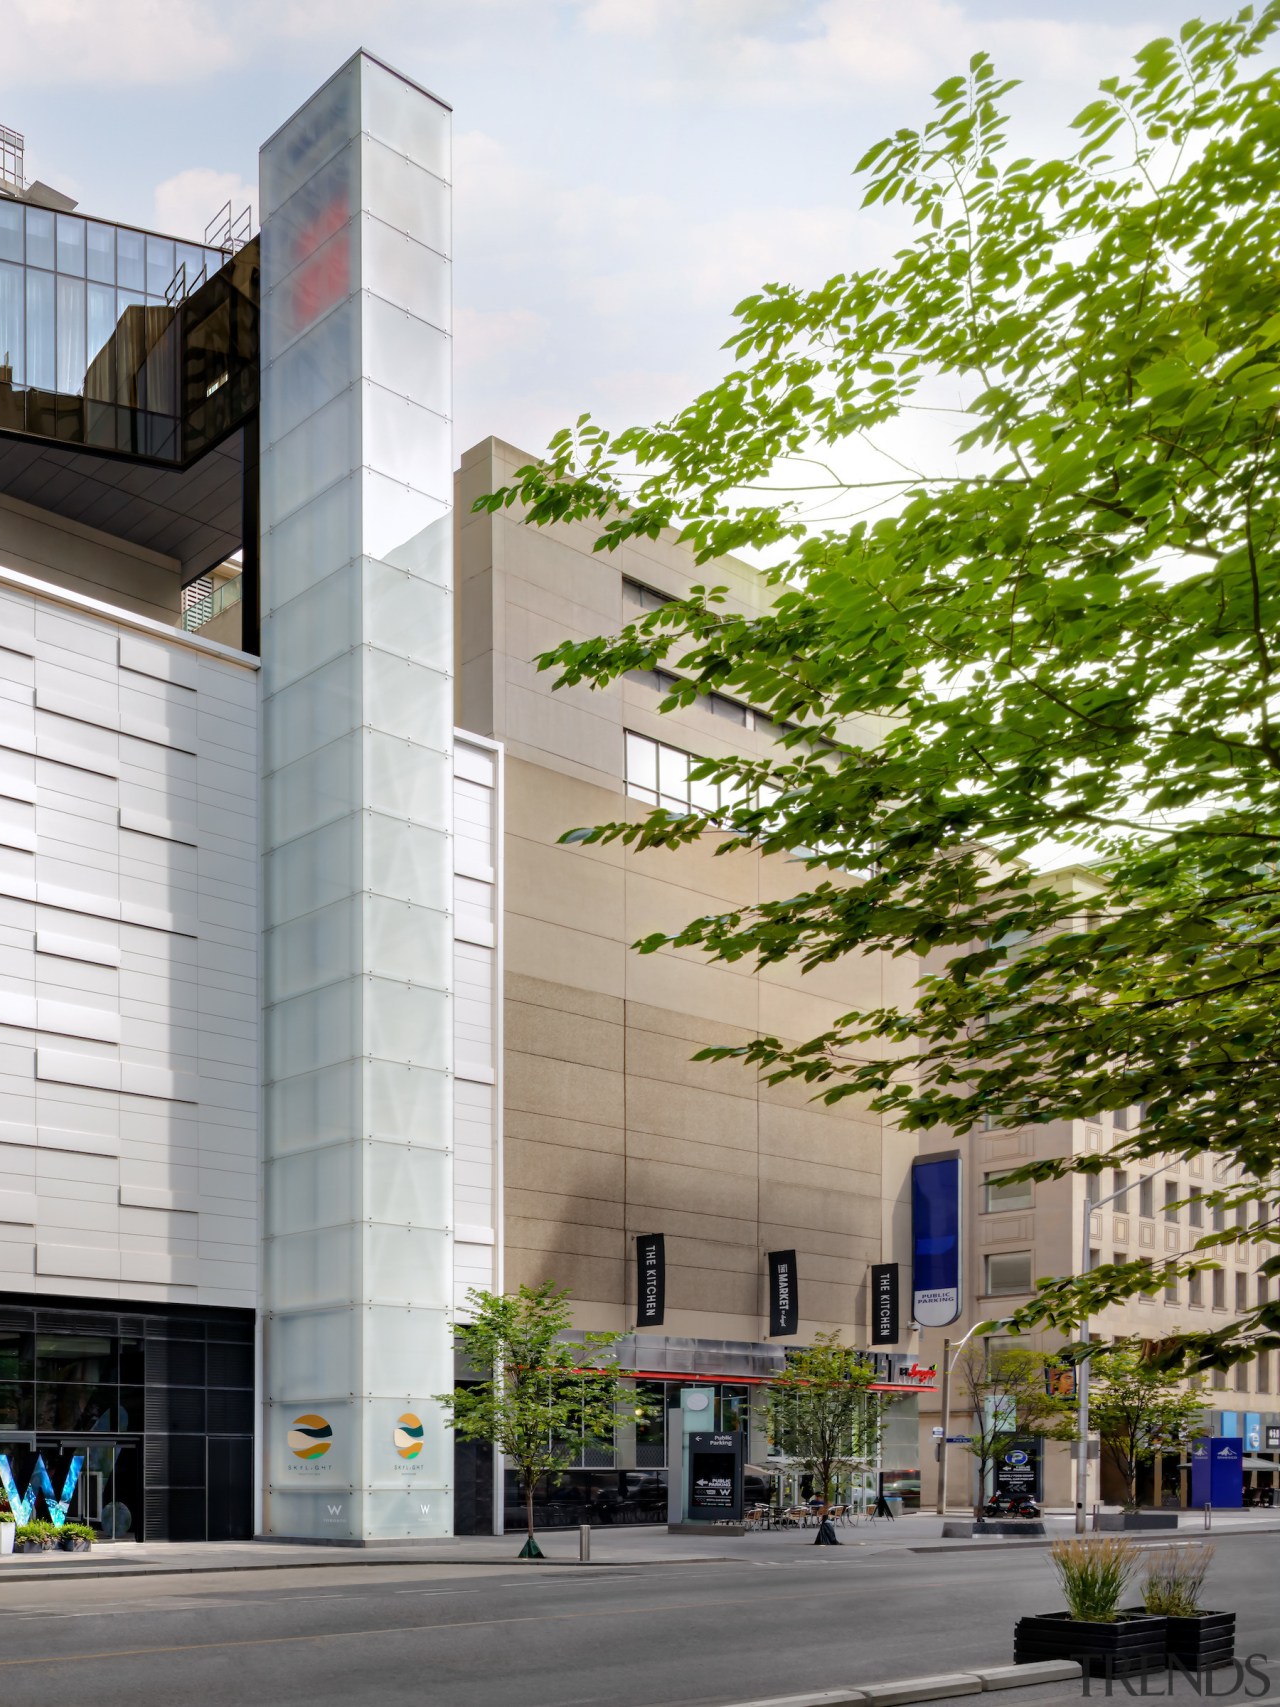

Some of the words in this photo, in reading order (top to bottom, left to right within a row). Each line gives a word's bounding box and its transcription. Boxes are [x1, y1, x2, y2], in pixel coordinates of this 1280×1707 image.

[646, 1245, 656, 1266] THE
[646, 1269, 657, 1316] KITCHEN
[779, 1273, 789, 1310] MARKET
[880, 1273, 890, 1291] THE
[880, 1294, 890, 1336] KITCHEN
[327, 1504, 342, 1516] W
[420, 1504, 430, 1515] W
